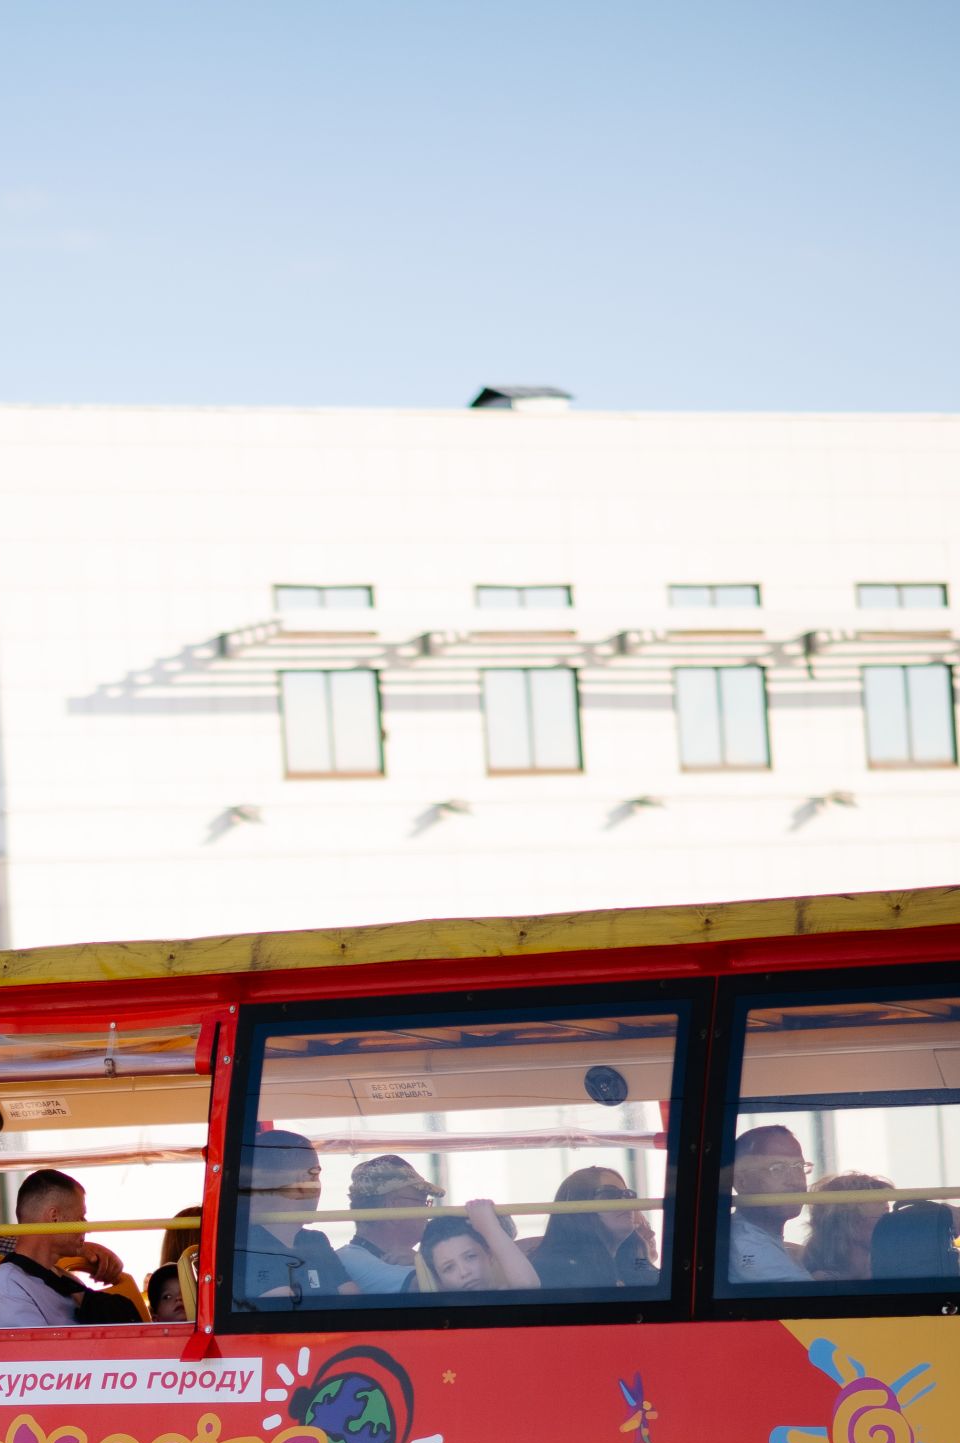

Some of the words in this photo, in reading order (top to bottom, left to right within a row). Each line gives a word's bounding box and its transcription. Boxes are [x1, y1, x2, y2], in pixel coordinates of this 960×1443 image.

[389, 1082, 427, 1090] СТЮАРТА
[385, 1090, 432, 1099] ОТКРЫВАТЬ
[101, 1371, 137, 1390] по
[147, 1370, 254, 1395] городу
